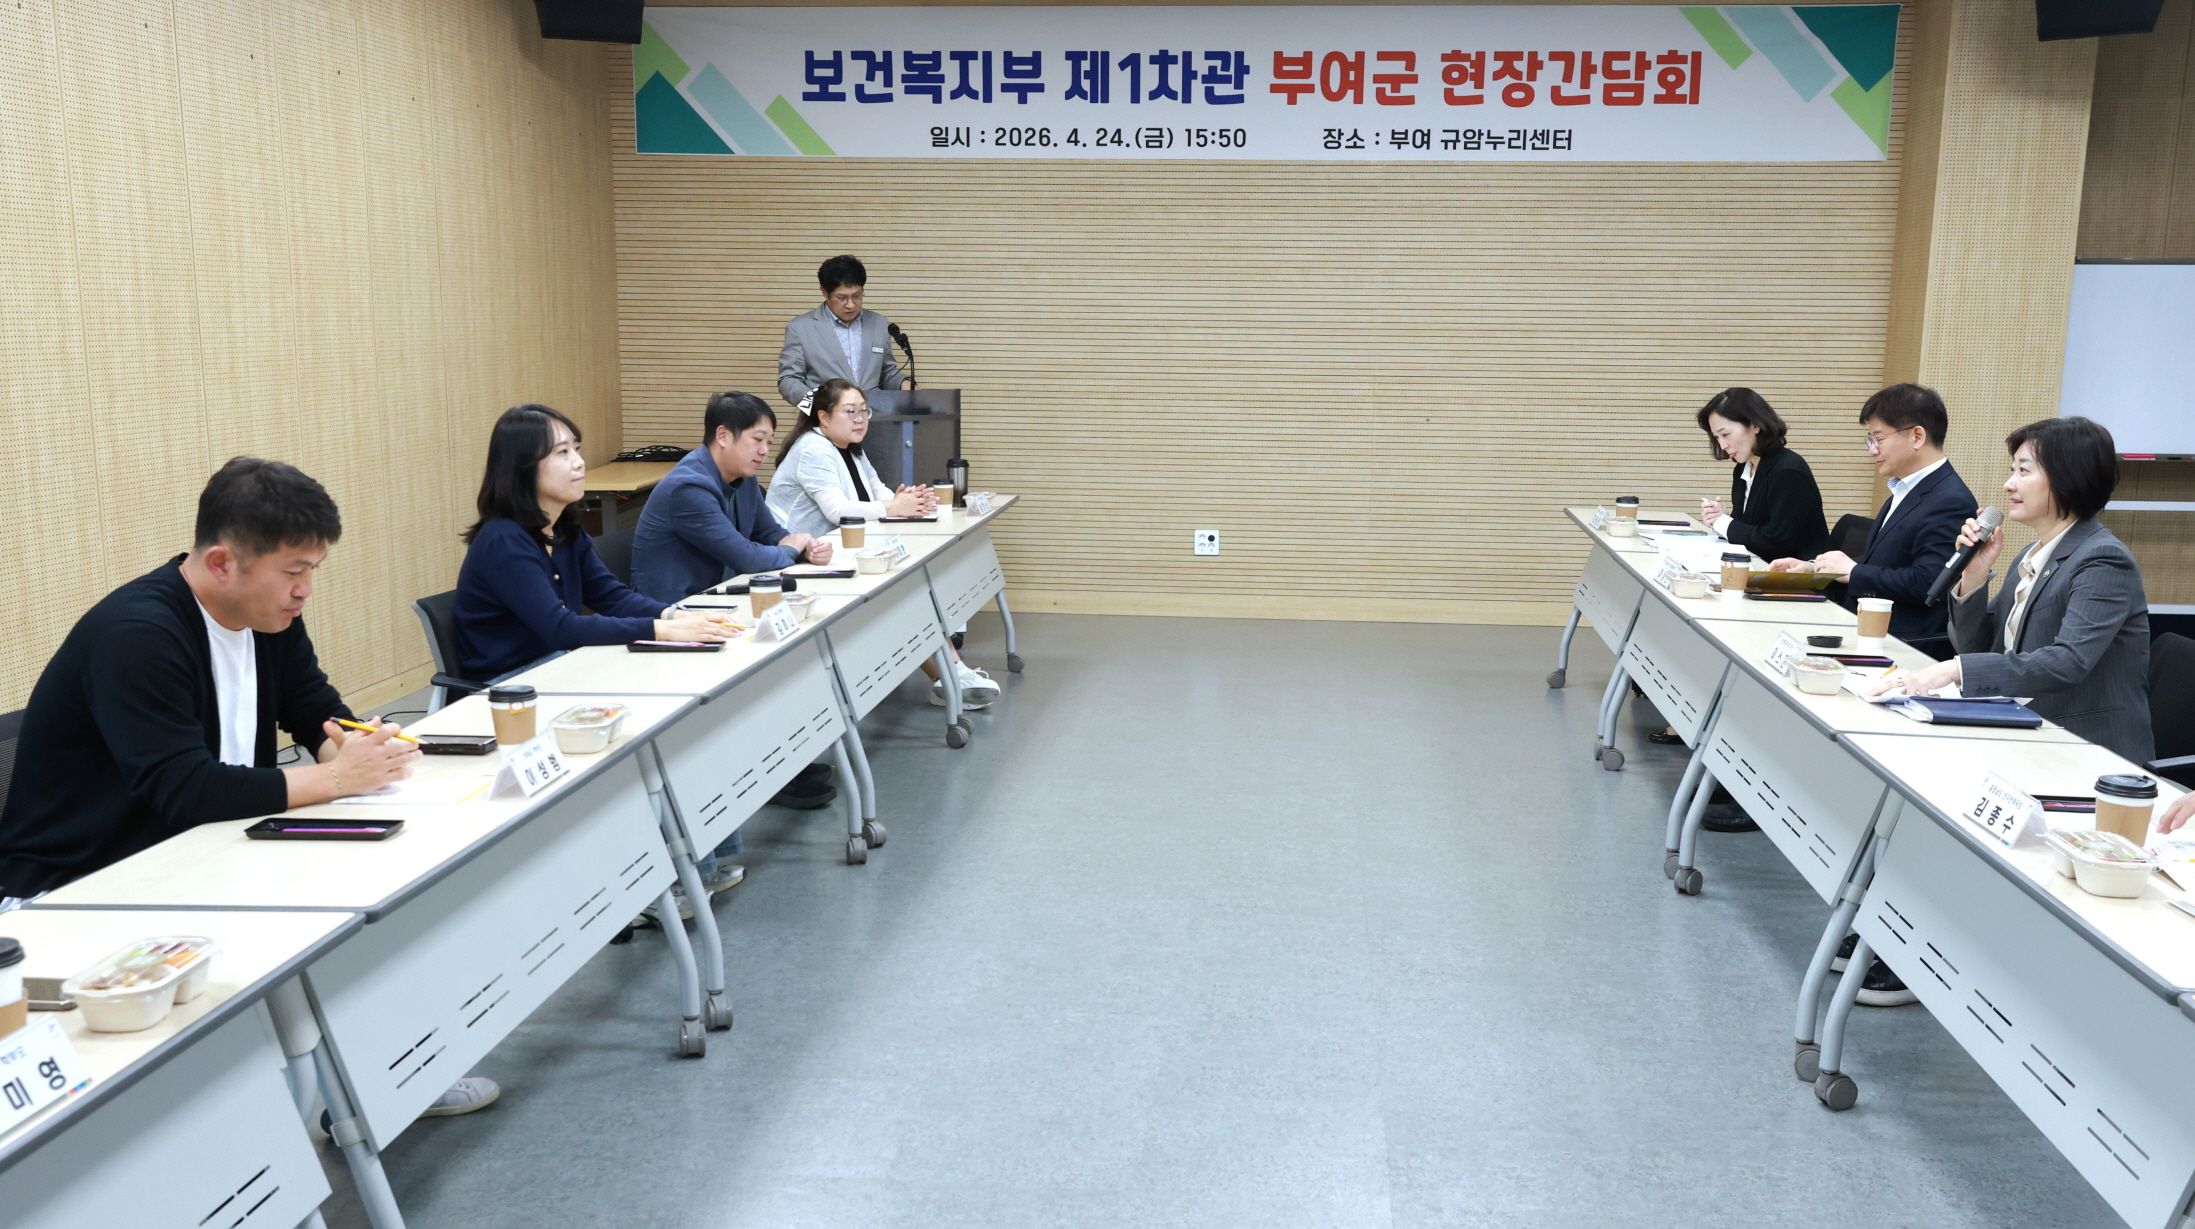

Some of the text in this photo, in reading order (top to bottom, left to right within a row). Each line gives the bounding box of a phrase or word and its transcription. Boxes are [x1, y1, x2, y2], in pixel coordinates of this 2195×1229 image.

[801, 49, 1702, 108] 보건복지부 제1차관 부여군 현장간담회
[930, 126, 971, 149] 일시
[994, 127, 1058, 148] 2026.
[1066, 127, 1087, 148] 4.
[1095, 127, 1174, 150] 24.(금)
[1184, 128, 1247, 148] 15:50
[1322, 128, 1366, 150] 장소
[1389, 128, 1431, 151] 부여
[1440, 128, 1573, 151] 규암누리센터
[1973, 796, 2016, 834] 김종수
